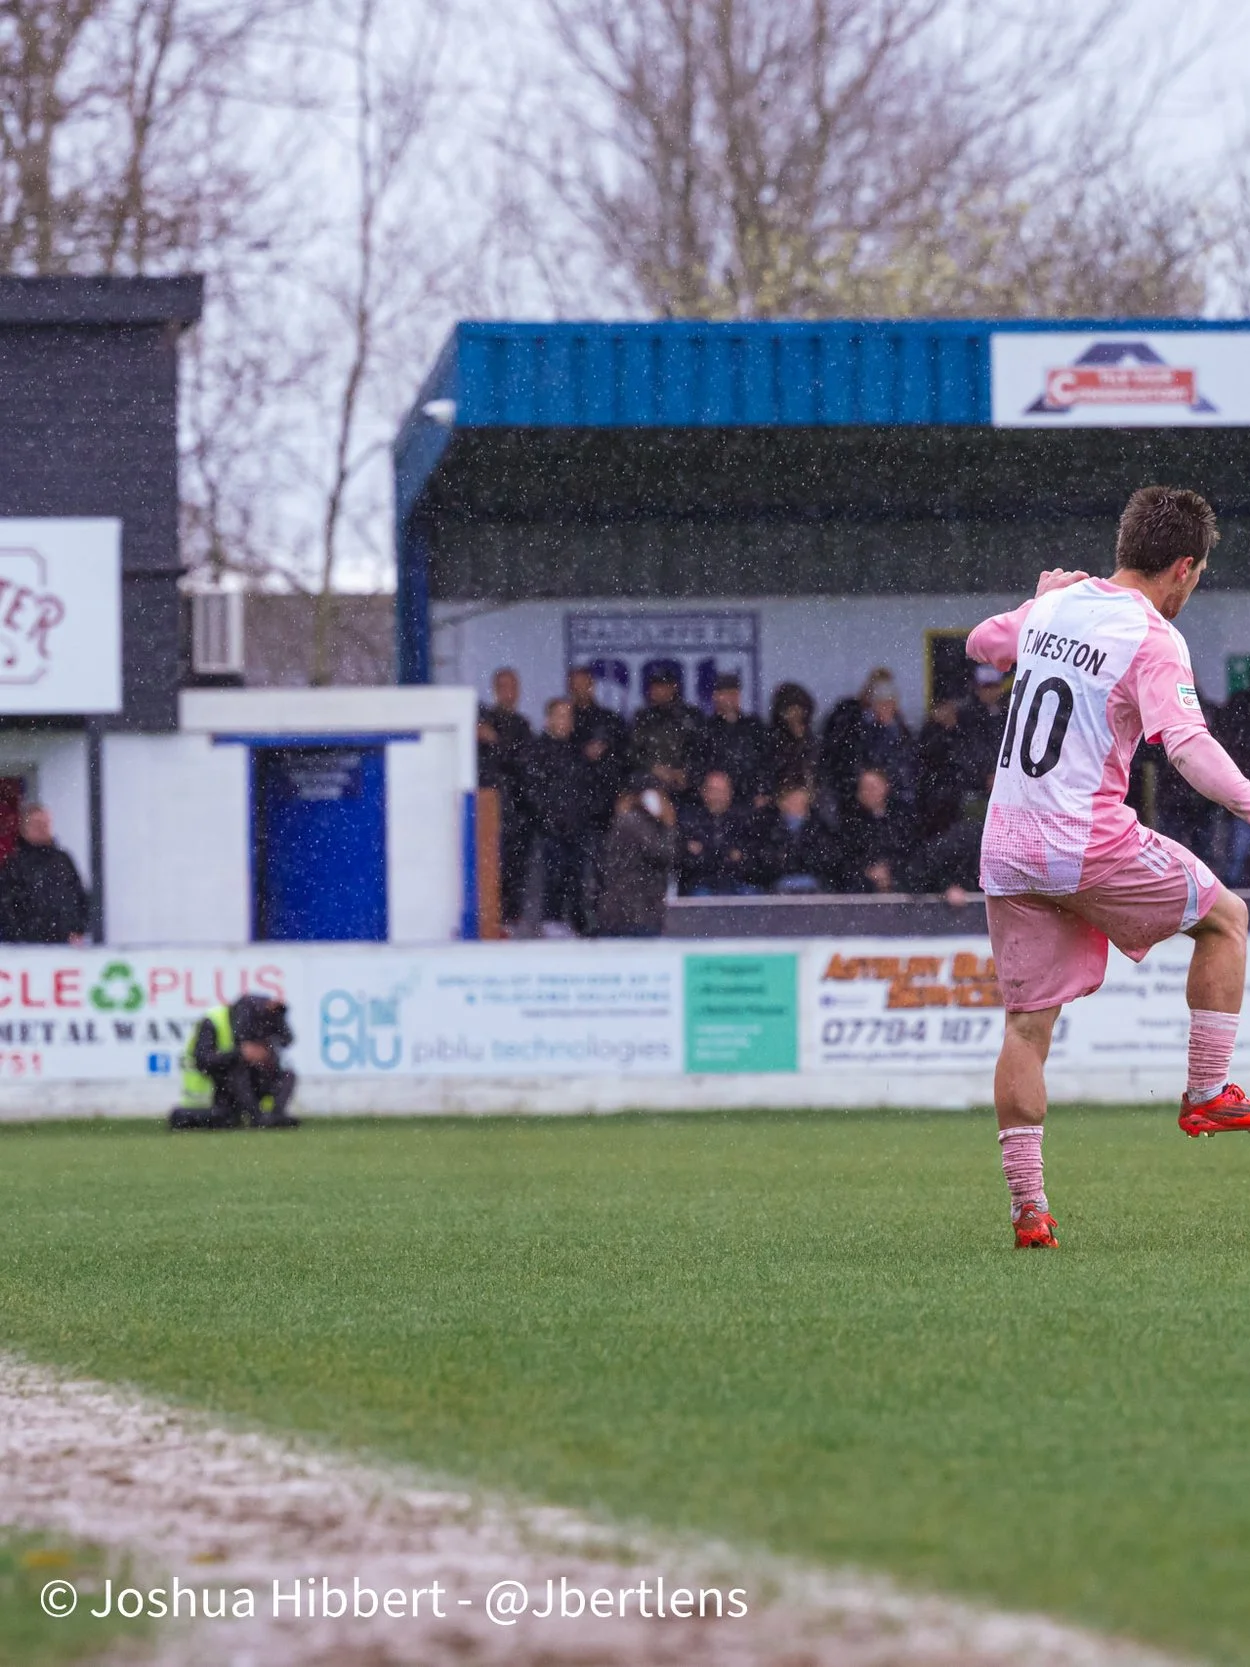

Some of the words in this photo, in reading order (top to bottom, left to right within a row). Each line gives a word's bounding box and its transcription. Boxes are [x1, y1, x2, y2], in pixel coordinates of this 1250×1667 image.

[1023, 628, 1107, 676] T.WESTON
[1000, 669, 1074, 778] 10
[149, 965, 286, 1007] PLUS
[491, 1033, 672, 1068] technologies
